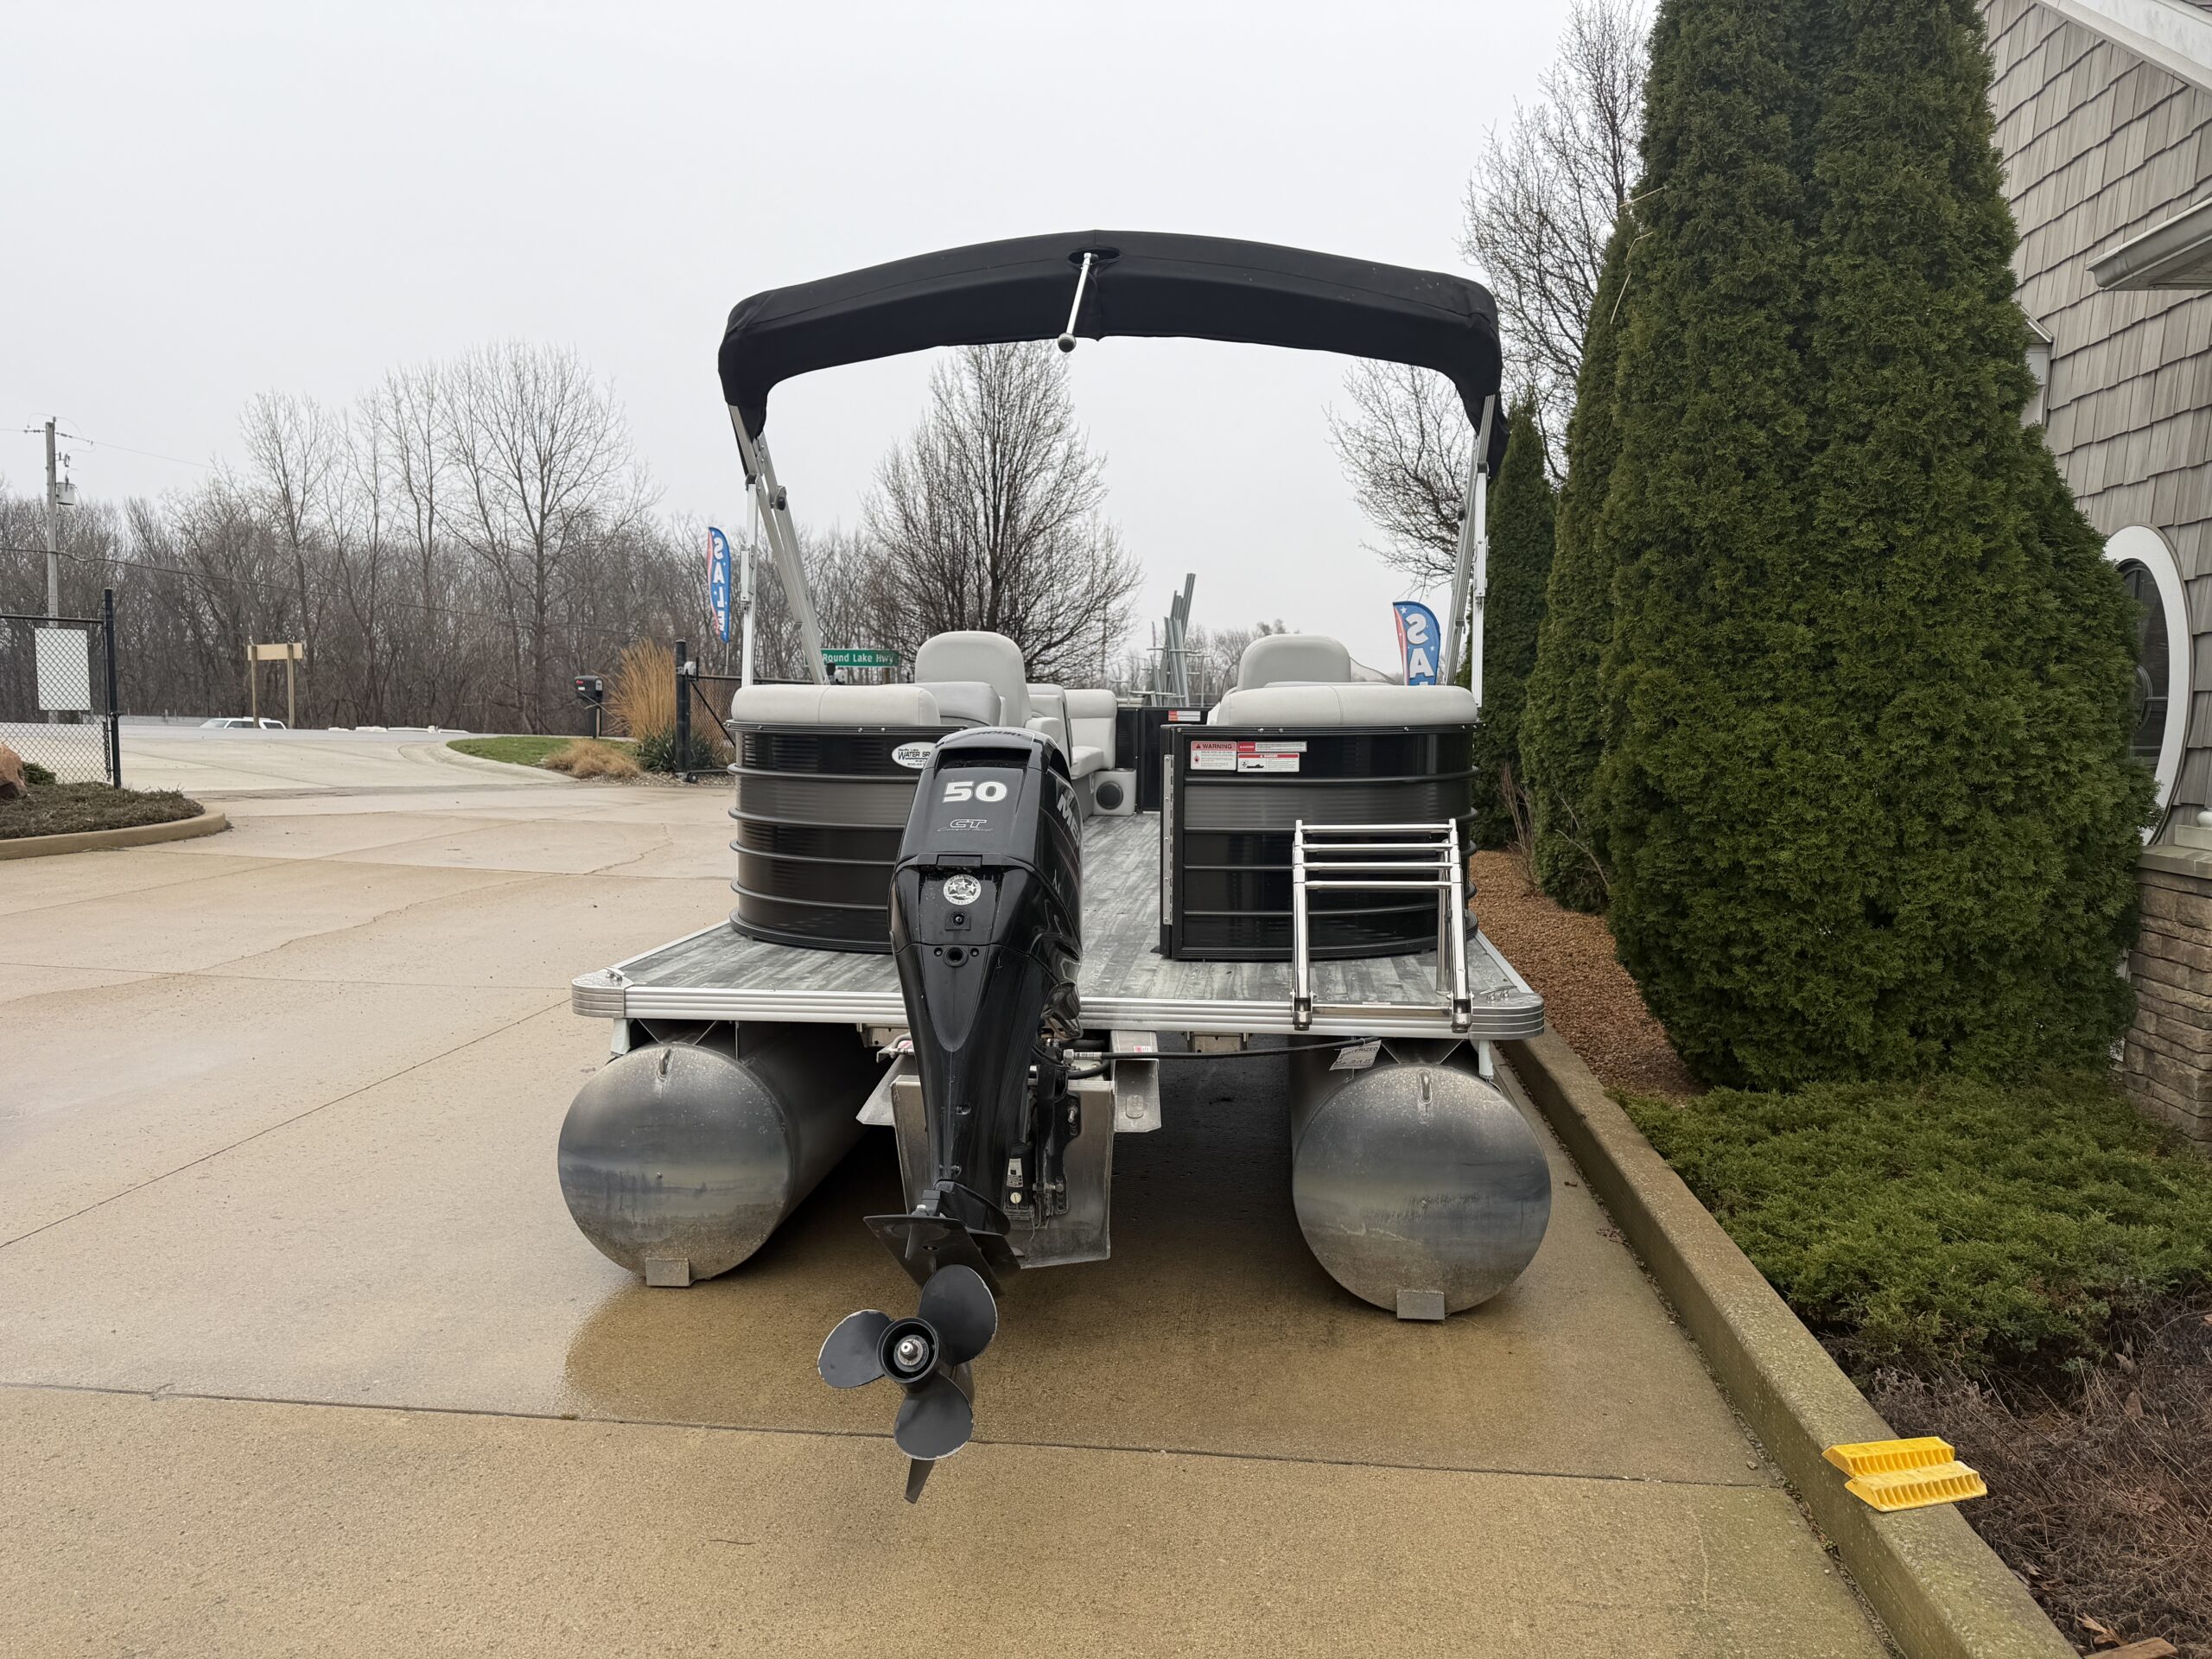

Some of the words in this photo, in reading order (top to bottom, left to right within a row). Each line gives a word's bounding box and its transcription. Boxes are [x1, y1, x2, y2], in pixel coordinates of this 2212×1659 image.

[823, 653, 849, 663] Round
[853, 653, 873, 663] Lake
[875, 653, 893, 664] Hwy
[898, 751, 920, 760] WATER
[943, 781, 1007, 804] 50
